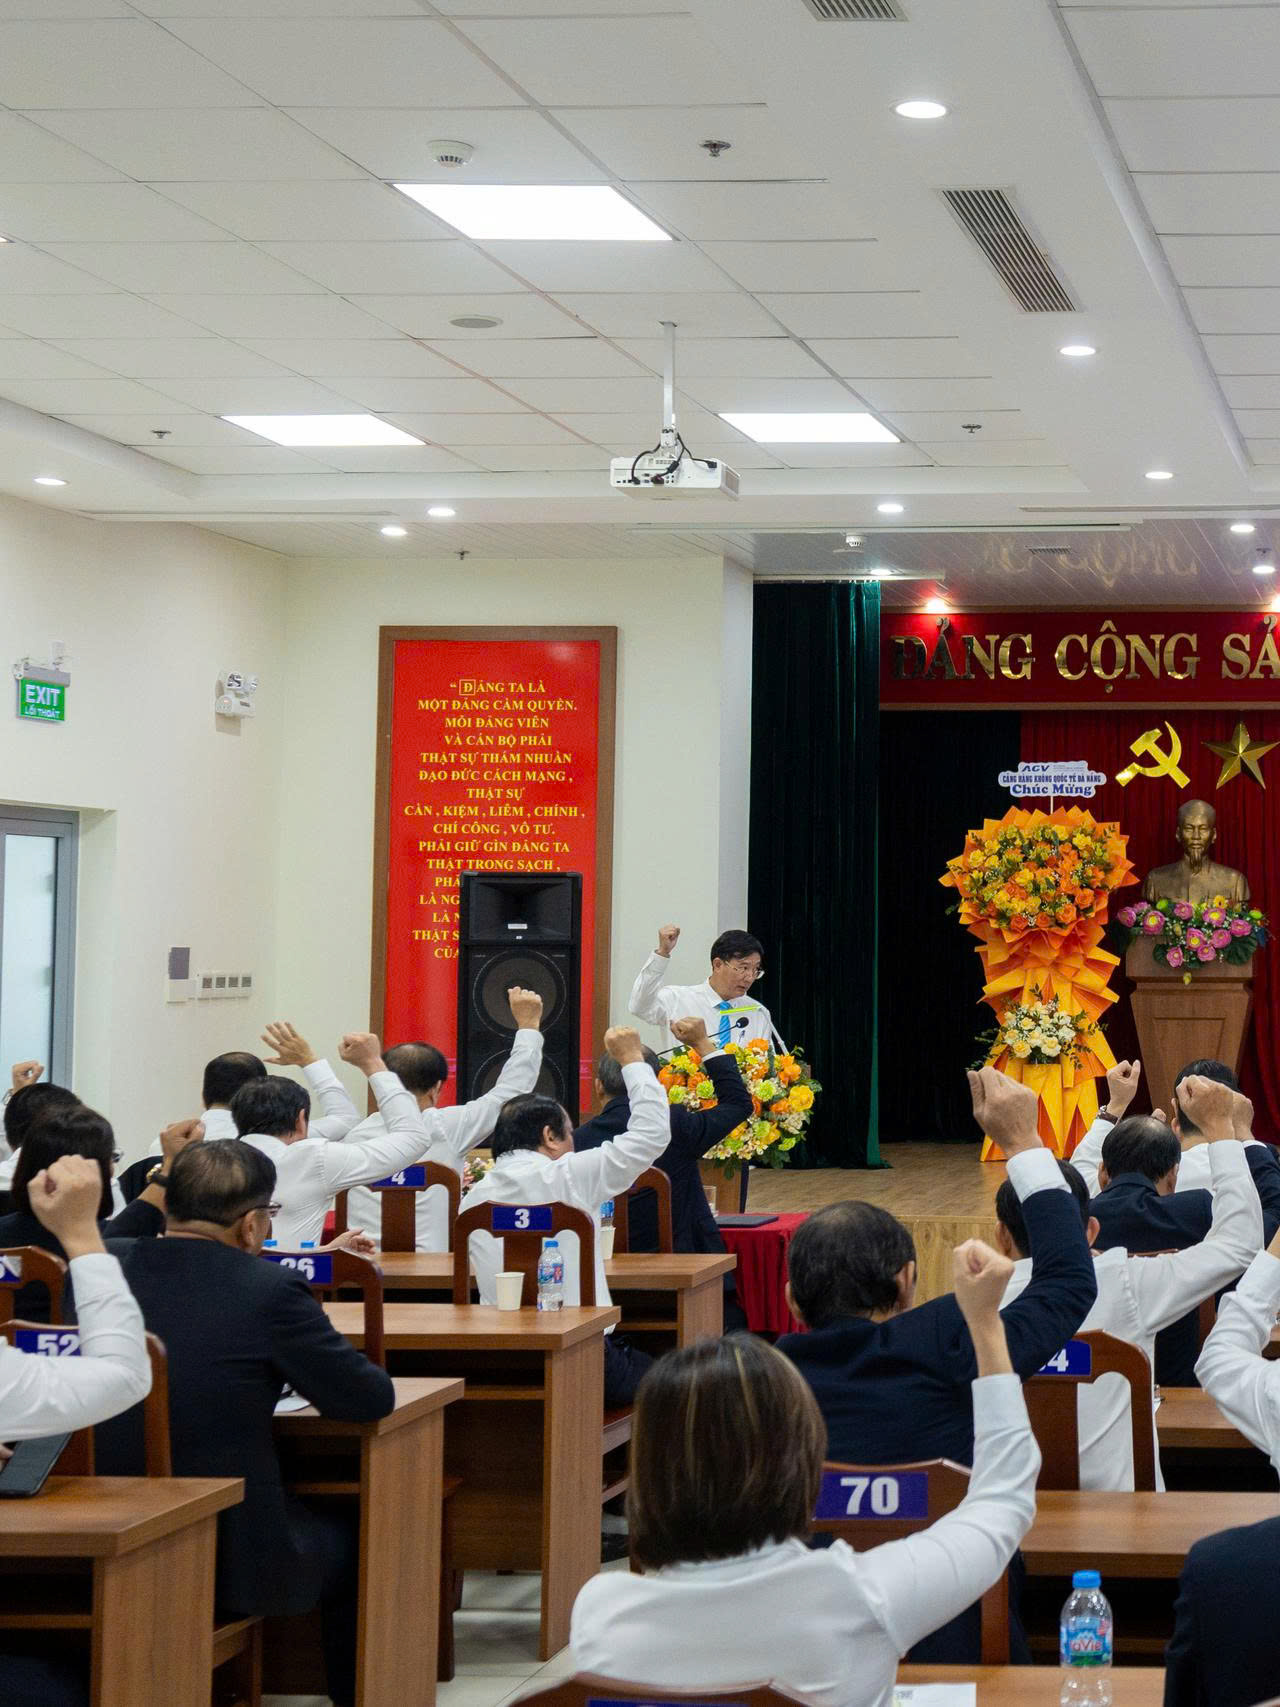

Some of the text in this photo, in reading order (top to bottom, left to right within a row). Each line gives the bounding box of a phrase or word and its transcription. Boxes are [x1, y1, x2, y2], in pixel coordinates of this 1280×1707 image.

[890, 616, 1036, 680] ĐẢNG
[1054, 620, 1201, 693] CỘNG
[509, 682, 525, 692] TA
[528, 679, 545, 692] LÀ
[25, 684, 61, 706] EXIT
[418, 698, 448, 713] MỘT
[452, 697, 489, 711] ĐẢNG
[516, 715, 549, 728] VIÊN
[444, 732, 552, 748] VÀ CÁN BỘ PHẢI
[420, 752, 457, 765] THẬT
[419, 770, 448, 784] ĐẠO
[483, 768, 521, 781] CÁCH
[467, 787, 503, 800] THẬT
[1012, 784, 1092, 796] Chúc Mừng
[433, 821, 458, 834] CHÍ
[511, 821, 530, 834] VÔ
[418, 840, 451, 852] PHẢI
[483, 839, 508, 852] GÌN
[512, 839, 549, 852] ĐẢNG
[553, 842, 570, 852] TA
[427, 858, 464, 871] THẬT
[467, 859, 514, 870] TRONG
[435, 875, 461, 888] PHẢ
[419, 893, 437, 905] LÀ
[432, 911, 450, 922] LÀ
[391, 1171, 406, 1185] 4
[514, 1208, 530, 1229] 3
[37, 1334, 80, 1356] 52
[1039, 1348, 1069, 1372] 4
[840, 1476, 899, 1516] 70
